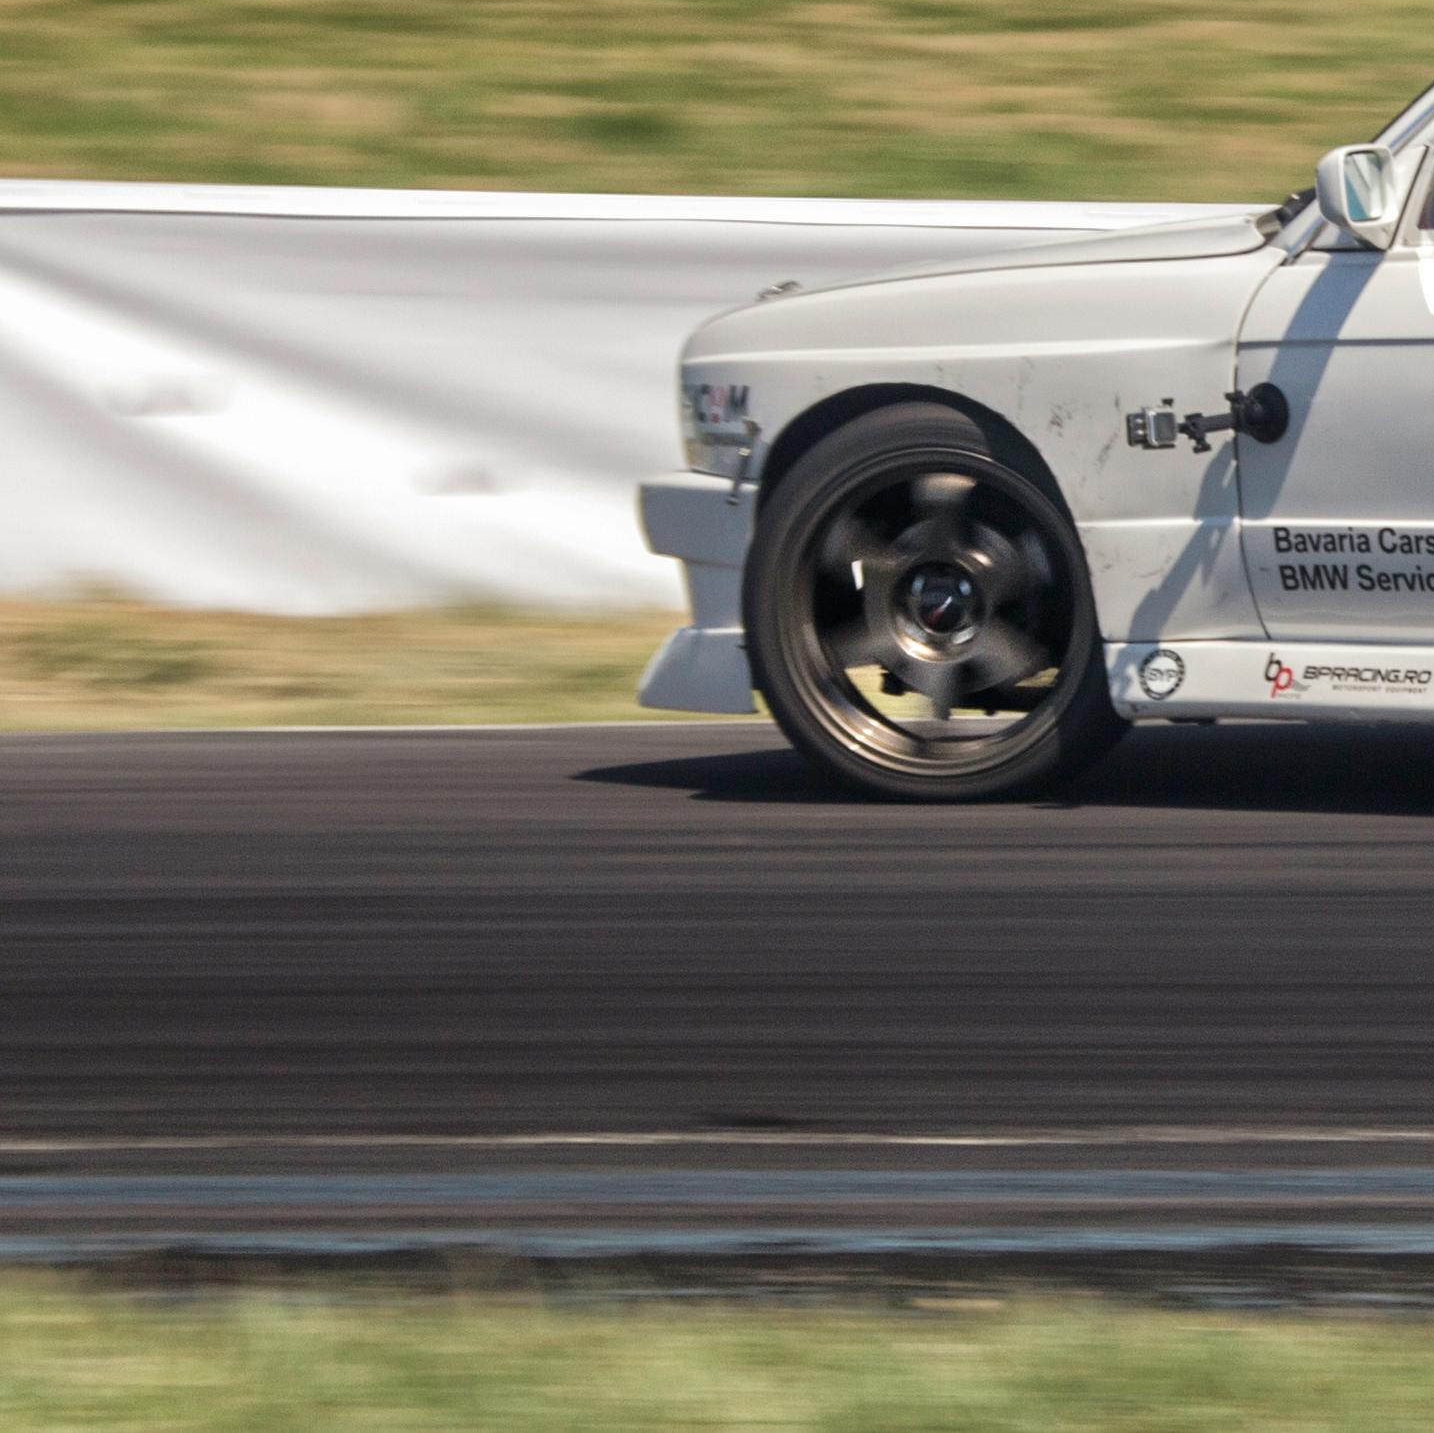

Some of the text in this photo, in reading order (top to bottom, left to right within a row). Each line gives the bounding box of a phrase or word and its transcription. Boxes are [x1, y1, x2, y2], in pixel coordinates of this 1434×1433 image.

[1273, 527, 1371, 554] Bavaria
[1279, 564, 1349, 591] BMW
[1302, 665, 1432, 685] BPRACING.RO
